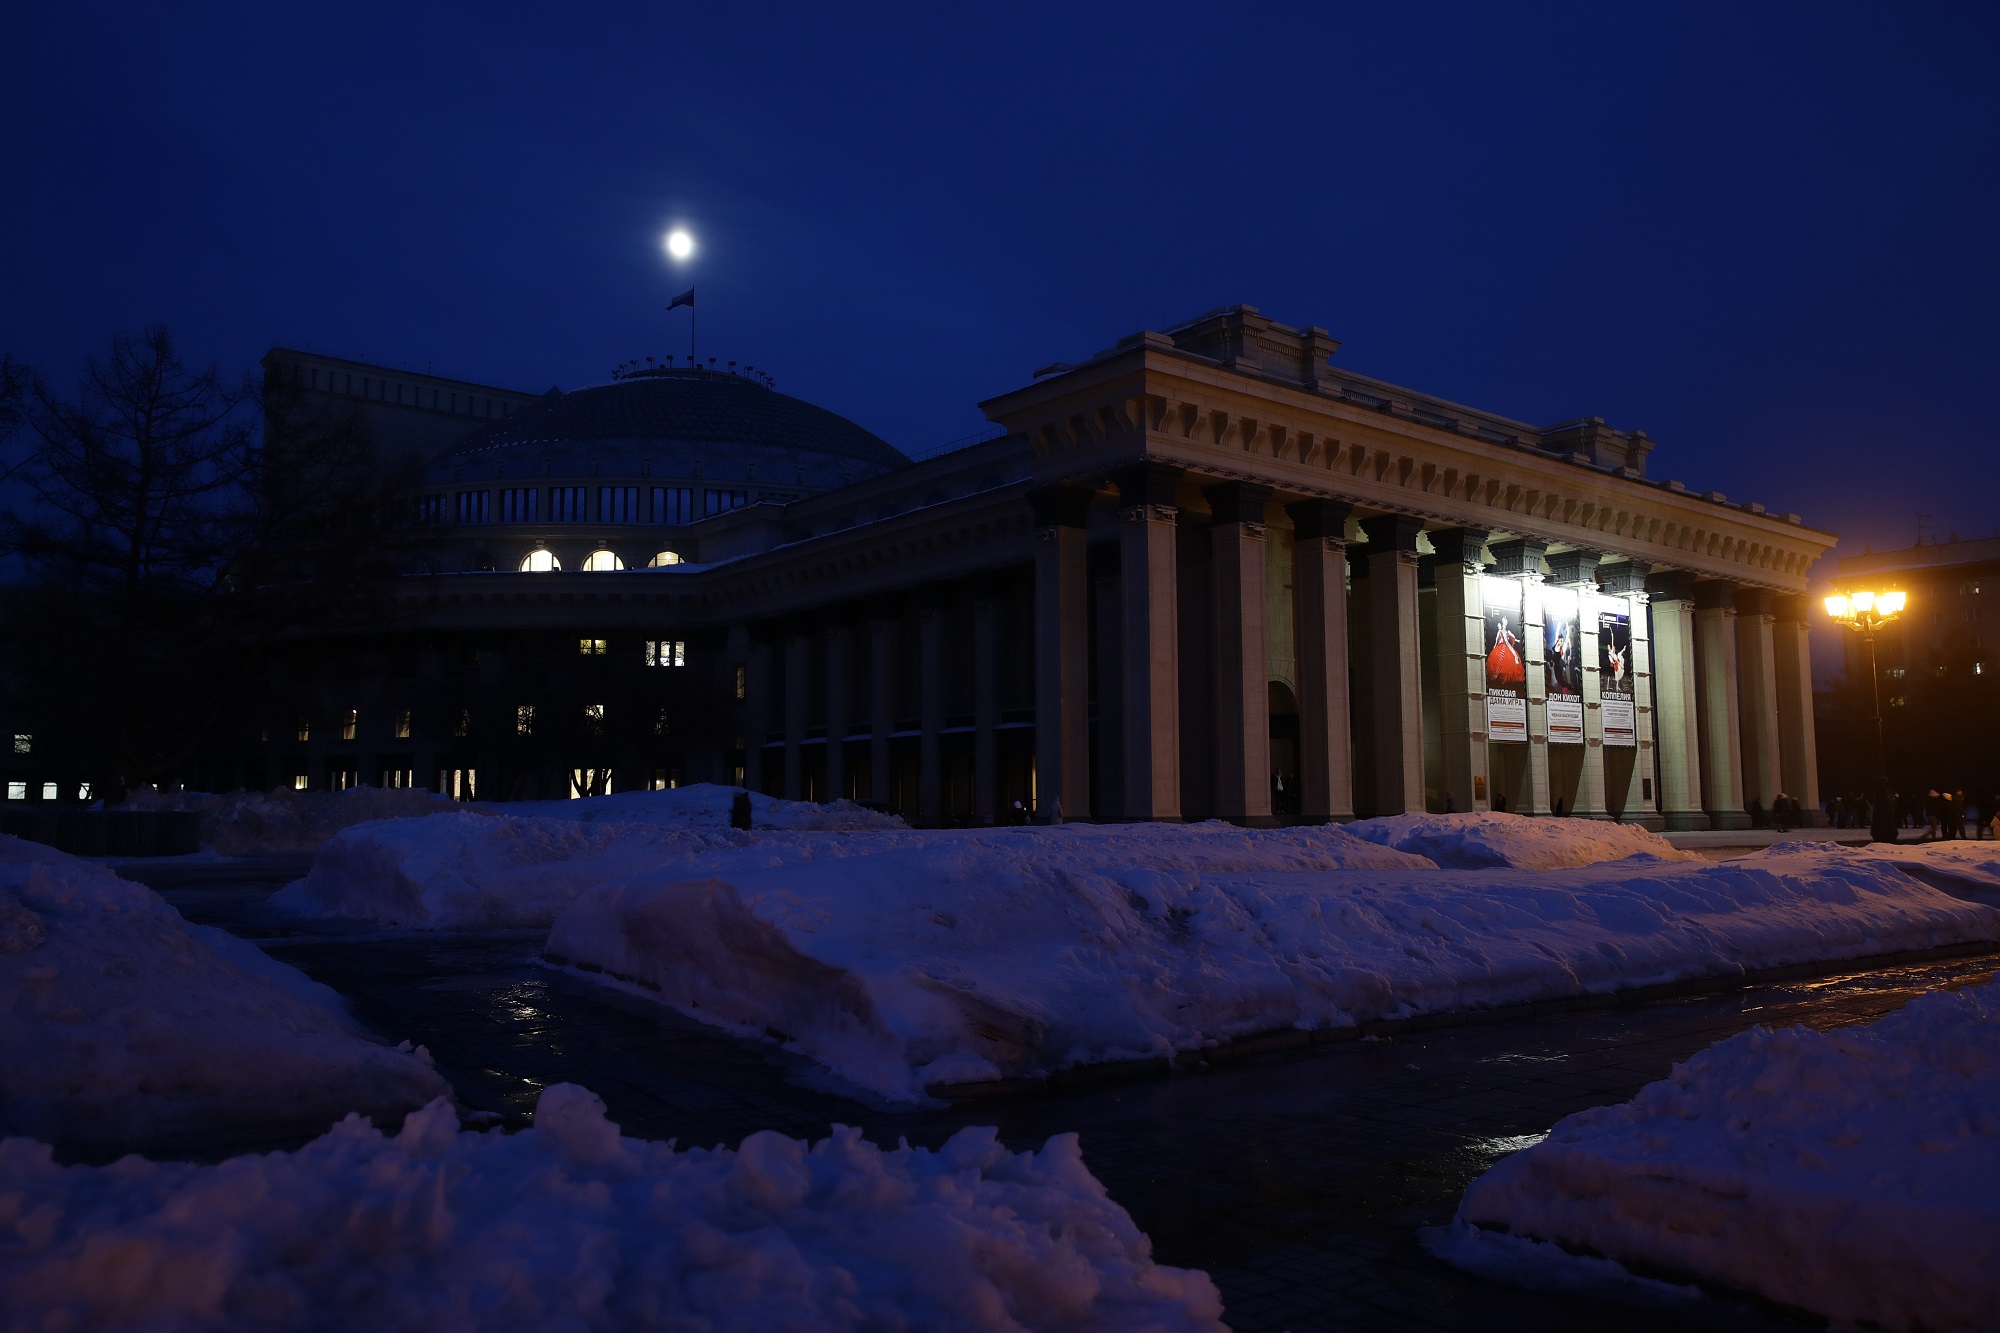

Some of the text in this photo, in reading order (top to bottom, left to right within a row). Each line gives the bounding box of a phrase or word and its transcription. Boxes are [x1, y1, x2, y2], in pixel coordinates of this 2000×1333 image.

[1489, 688, 1516, 697] ПИКОВАЯ
[1549, 692, 1580, 702] ДОН КИХОТ
[1602, 692, 1630, 700] КОППЕЛИЯ
